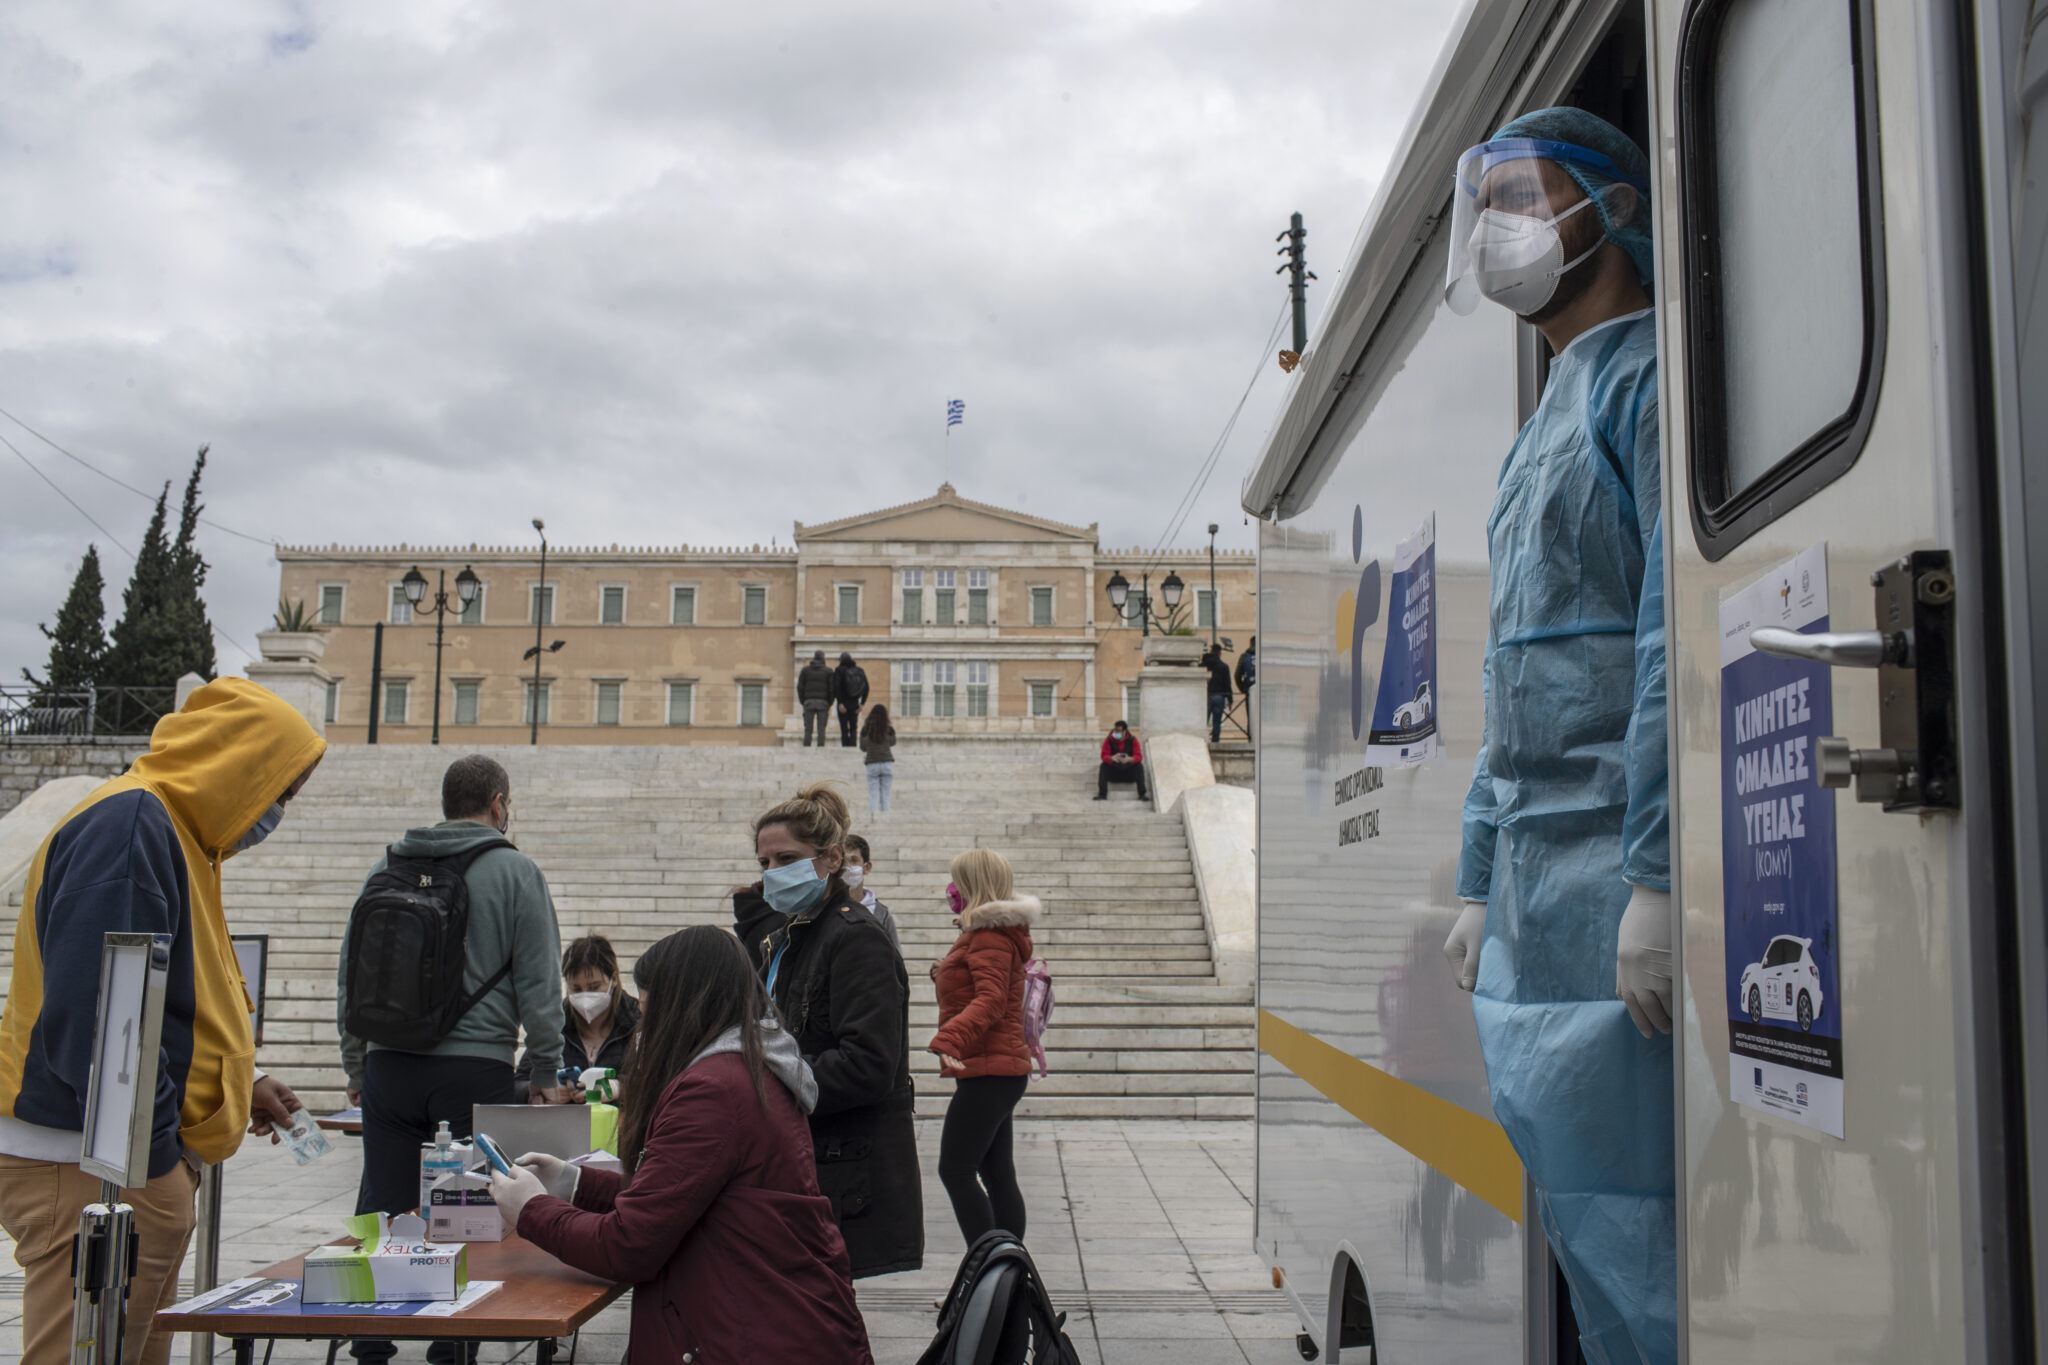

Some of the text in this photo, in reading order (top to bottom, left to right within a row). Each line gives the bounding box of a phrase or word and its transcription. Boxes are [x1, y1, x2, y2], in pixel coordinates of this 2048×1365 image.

[1735, 677, 1811, 745] ΚΙΝΗΤΕΣ
[1736, 736, 1809, 796] ΟΜΑΔΕΣ
[1743, 794, 1805, 845] ΥΓΕΙΑΣ
[1755, 843, 1792, 881] (ΚΟΜΥ)
[117, 1017, 132, 1086] 1
[409, 1256, 451, 1266] PROTEX
